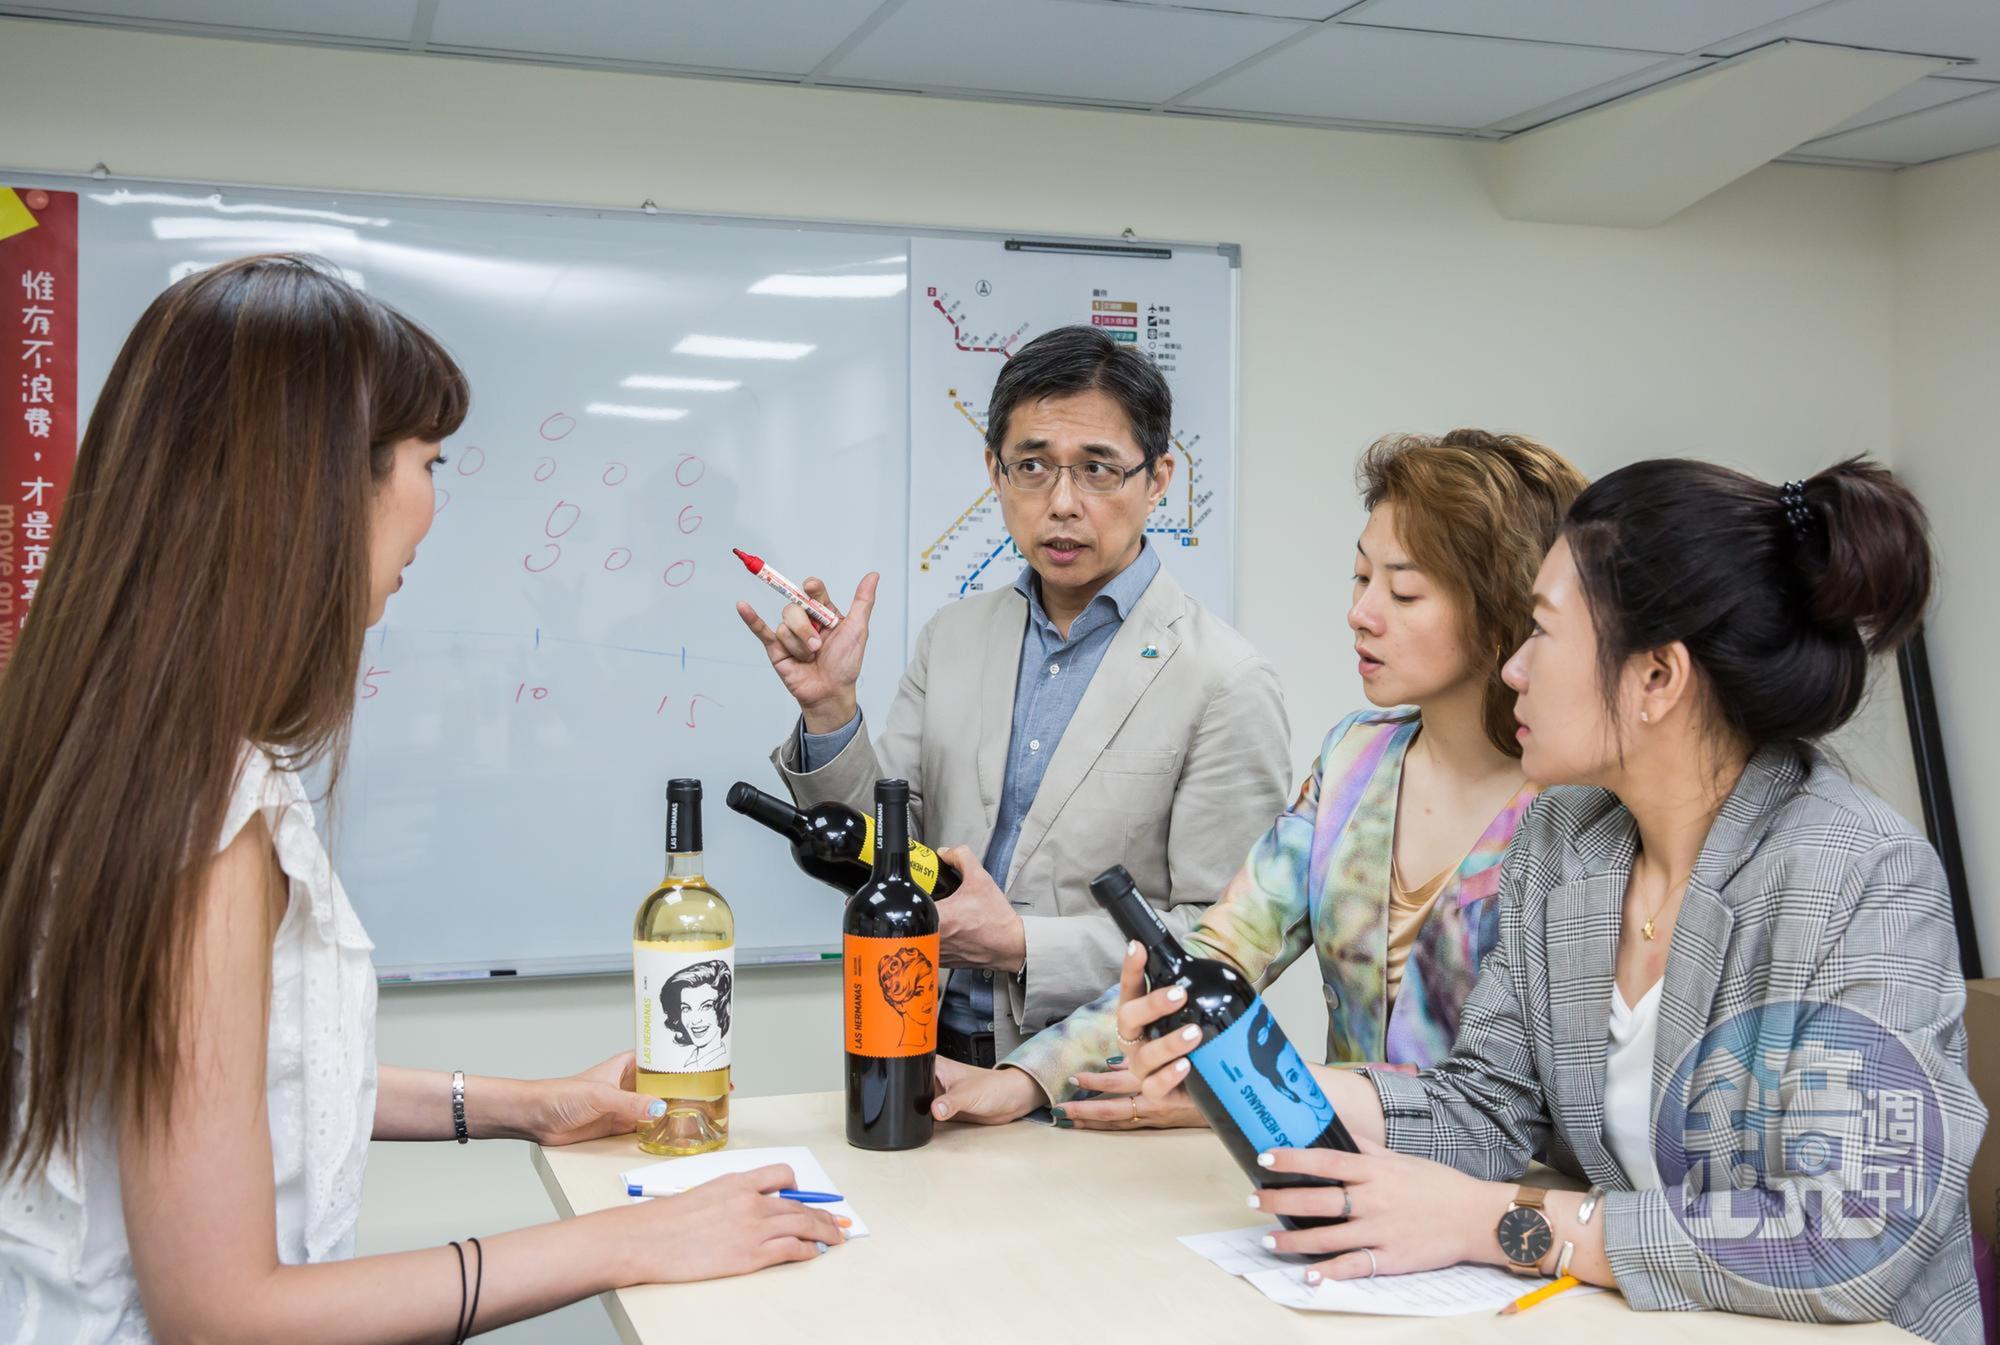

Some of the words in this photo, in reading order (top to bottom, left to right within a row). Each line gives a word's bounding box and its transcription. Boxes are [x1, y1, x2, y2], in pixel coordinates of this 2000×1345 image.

[0, 504, 14, 576] move
[0, 581, 14, 615] on
[515, 683, 548, 703] 10
[910, 860, 924, 873] HER
[923, 867, 935, 879] LAS
[854, 983, 862, 1031] HERMANAS
[643, 998, 651, 1046] HERMANAS
[854, 1032, 862, 1049] LAS
[643, 1047, 651, 1063] LAS
[1240, 1084, 1280, 1135] HERMANAS
